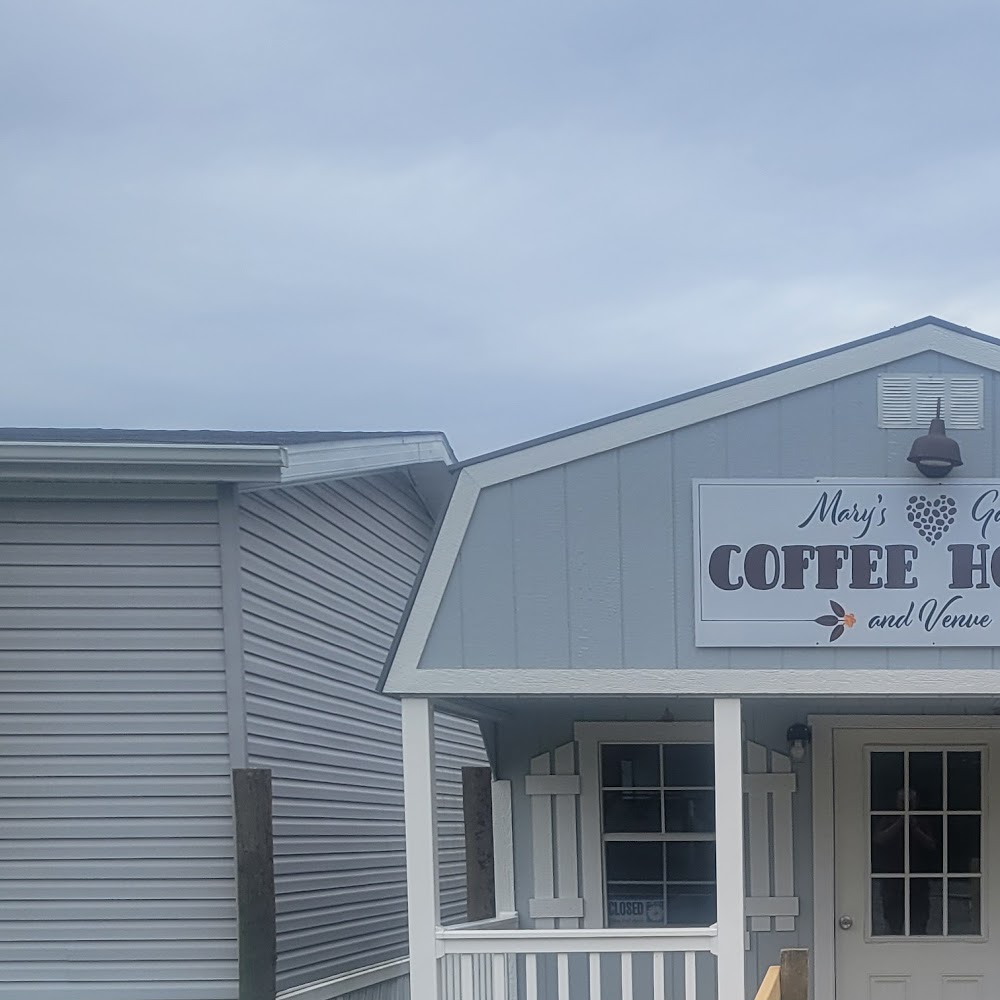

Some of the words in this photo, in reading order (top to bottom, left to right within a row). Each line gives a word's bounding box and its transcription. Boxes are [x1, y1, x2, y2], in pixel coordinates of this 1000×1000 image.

[797, 489, 887, 539] Mary's
[708, 543, 919, 591] COFFEE
[868, 601, 915, 629] and
[918, 595, 993, 632] Venue
[608, 901, 644, 916] CLOSED
